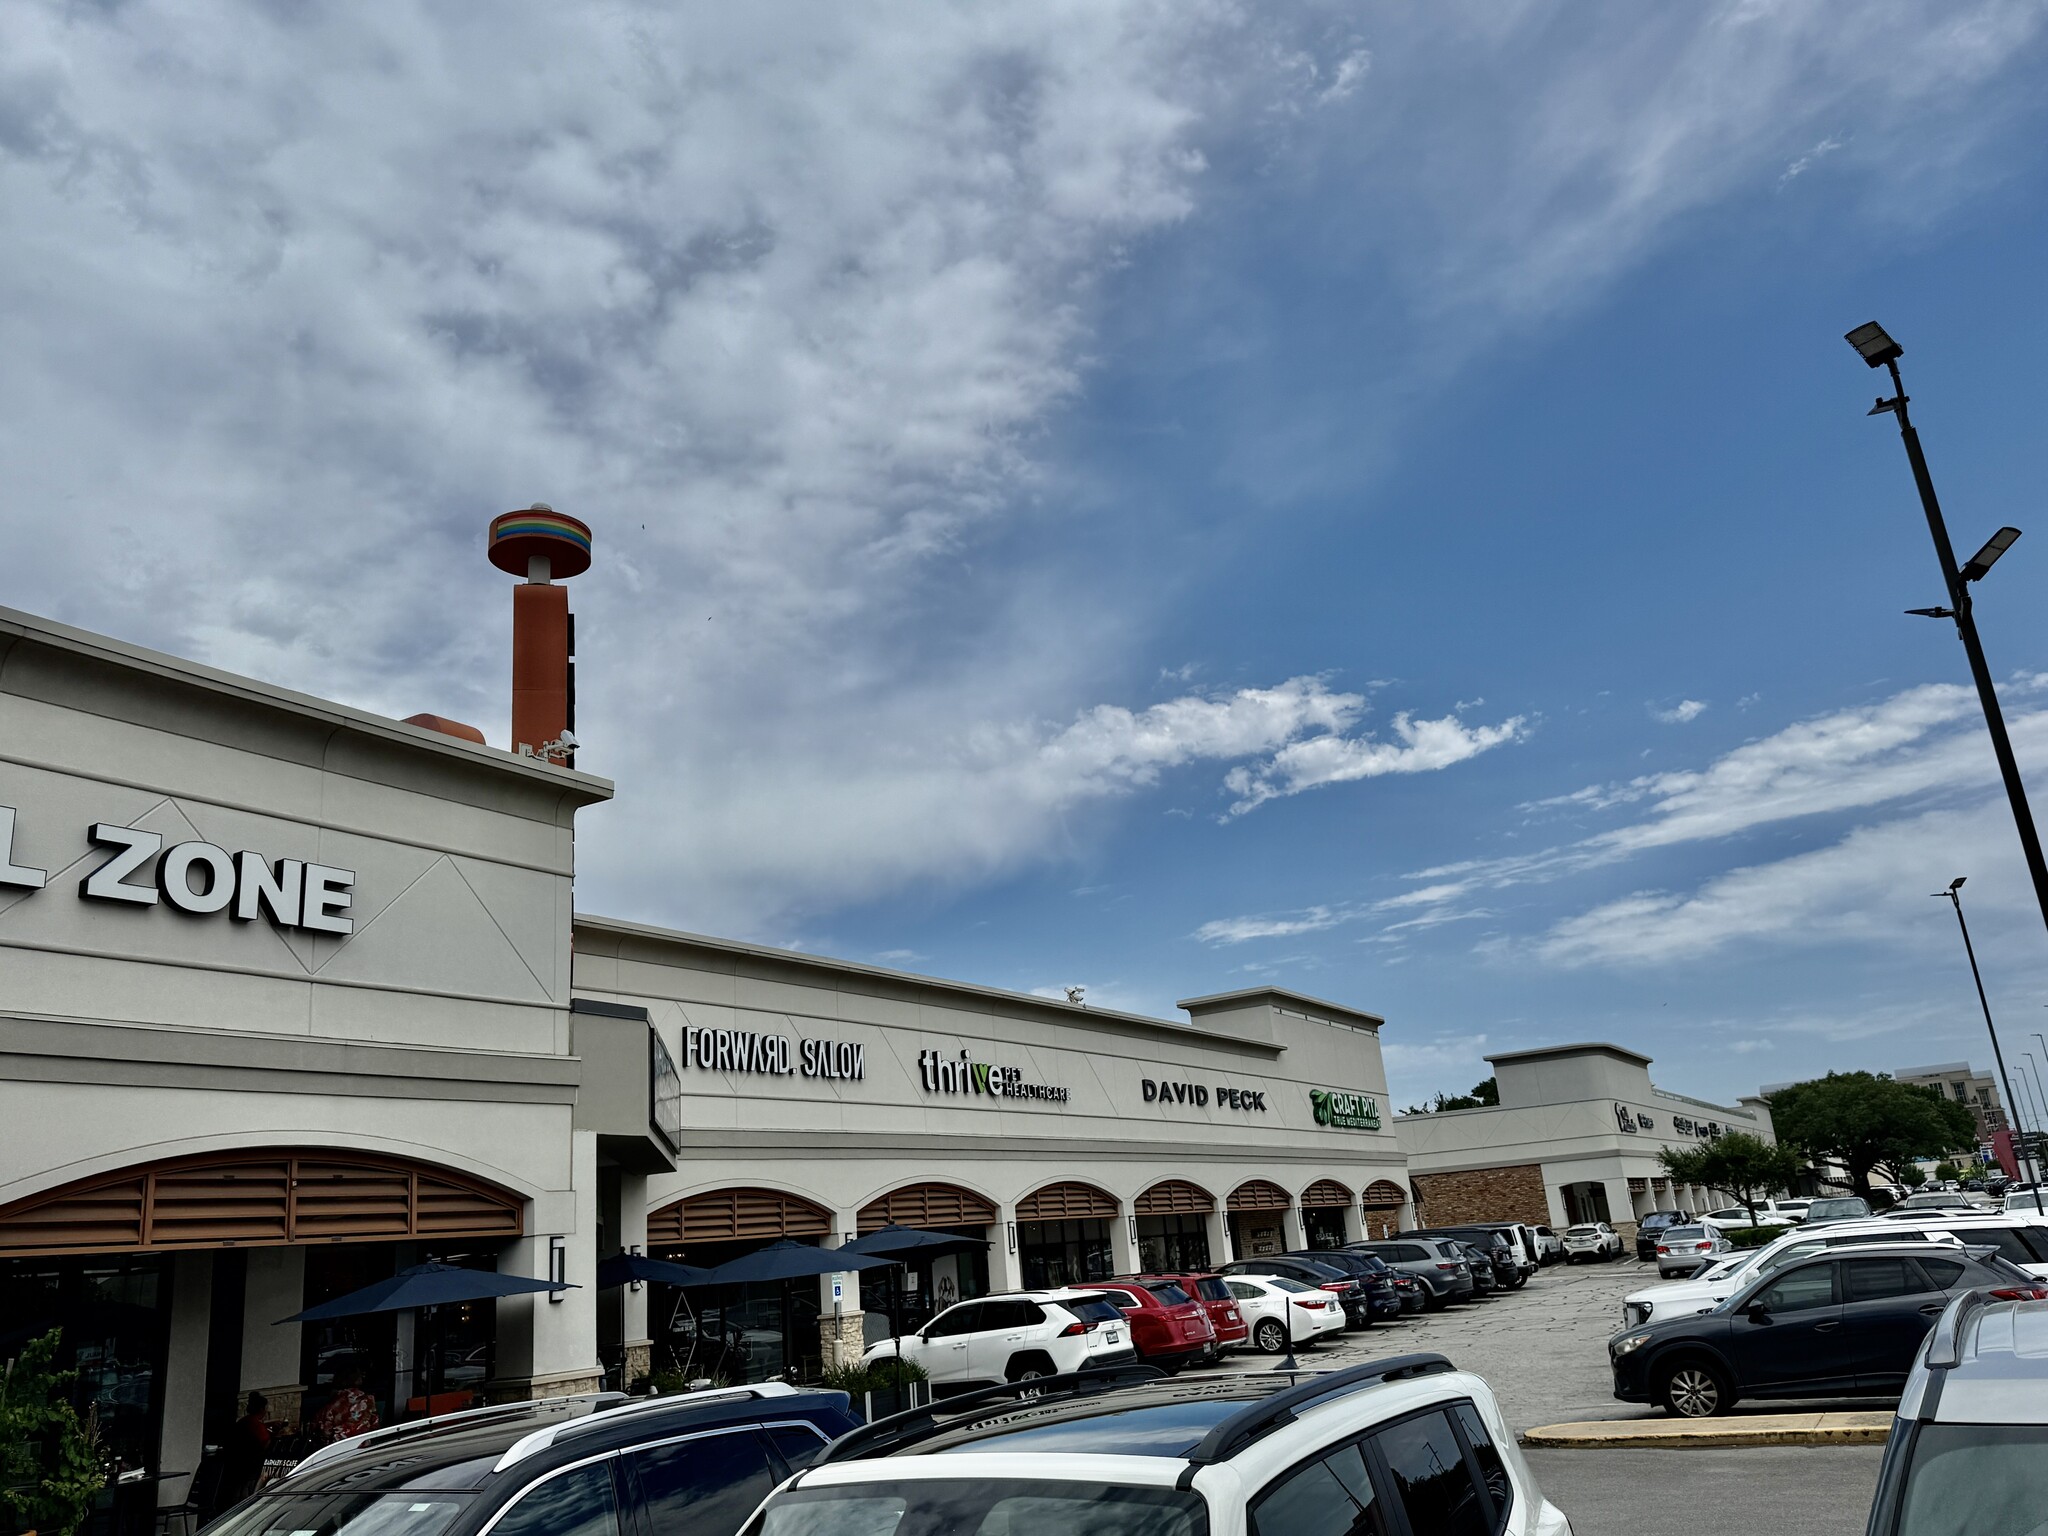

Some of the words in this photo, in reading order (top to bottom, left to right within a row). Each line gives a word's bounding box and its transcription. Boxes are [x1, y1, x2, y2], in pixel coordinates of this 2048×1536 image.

[79, 823, 355, 935] ZONE
[801, 1038, 866, 1080] SALON
[918, 1048, 1003, 1097] thrive
[1003, 1067, 1023, 1081] PET
[1005, 1083, 1071, 1102] HEALTHCARE
[1142, 1079, 1208, 1107] DAVID
[1216, 1087, 1267, 1112] PECK
[1331, 1093, 1360, 1116] CRAFT
[1361, 1096, 1380, 1118] PITA
